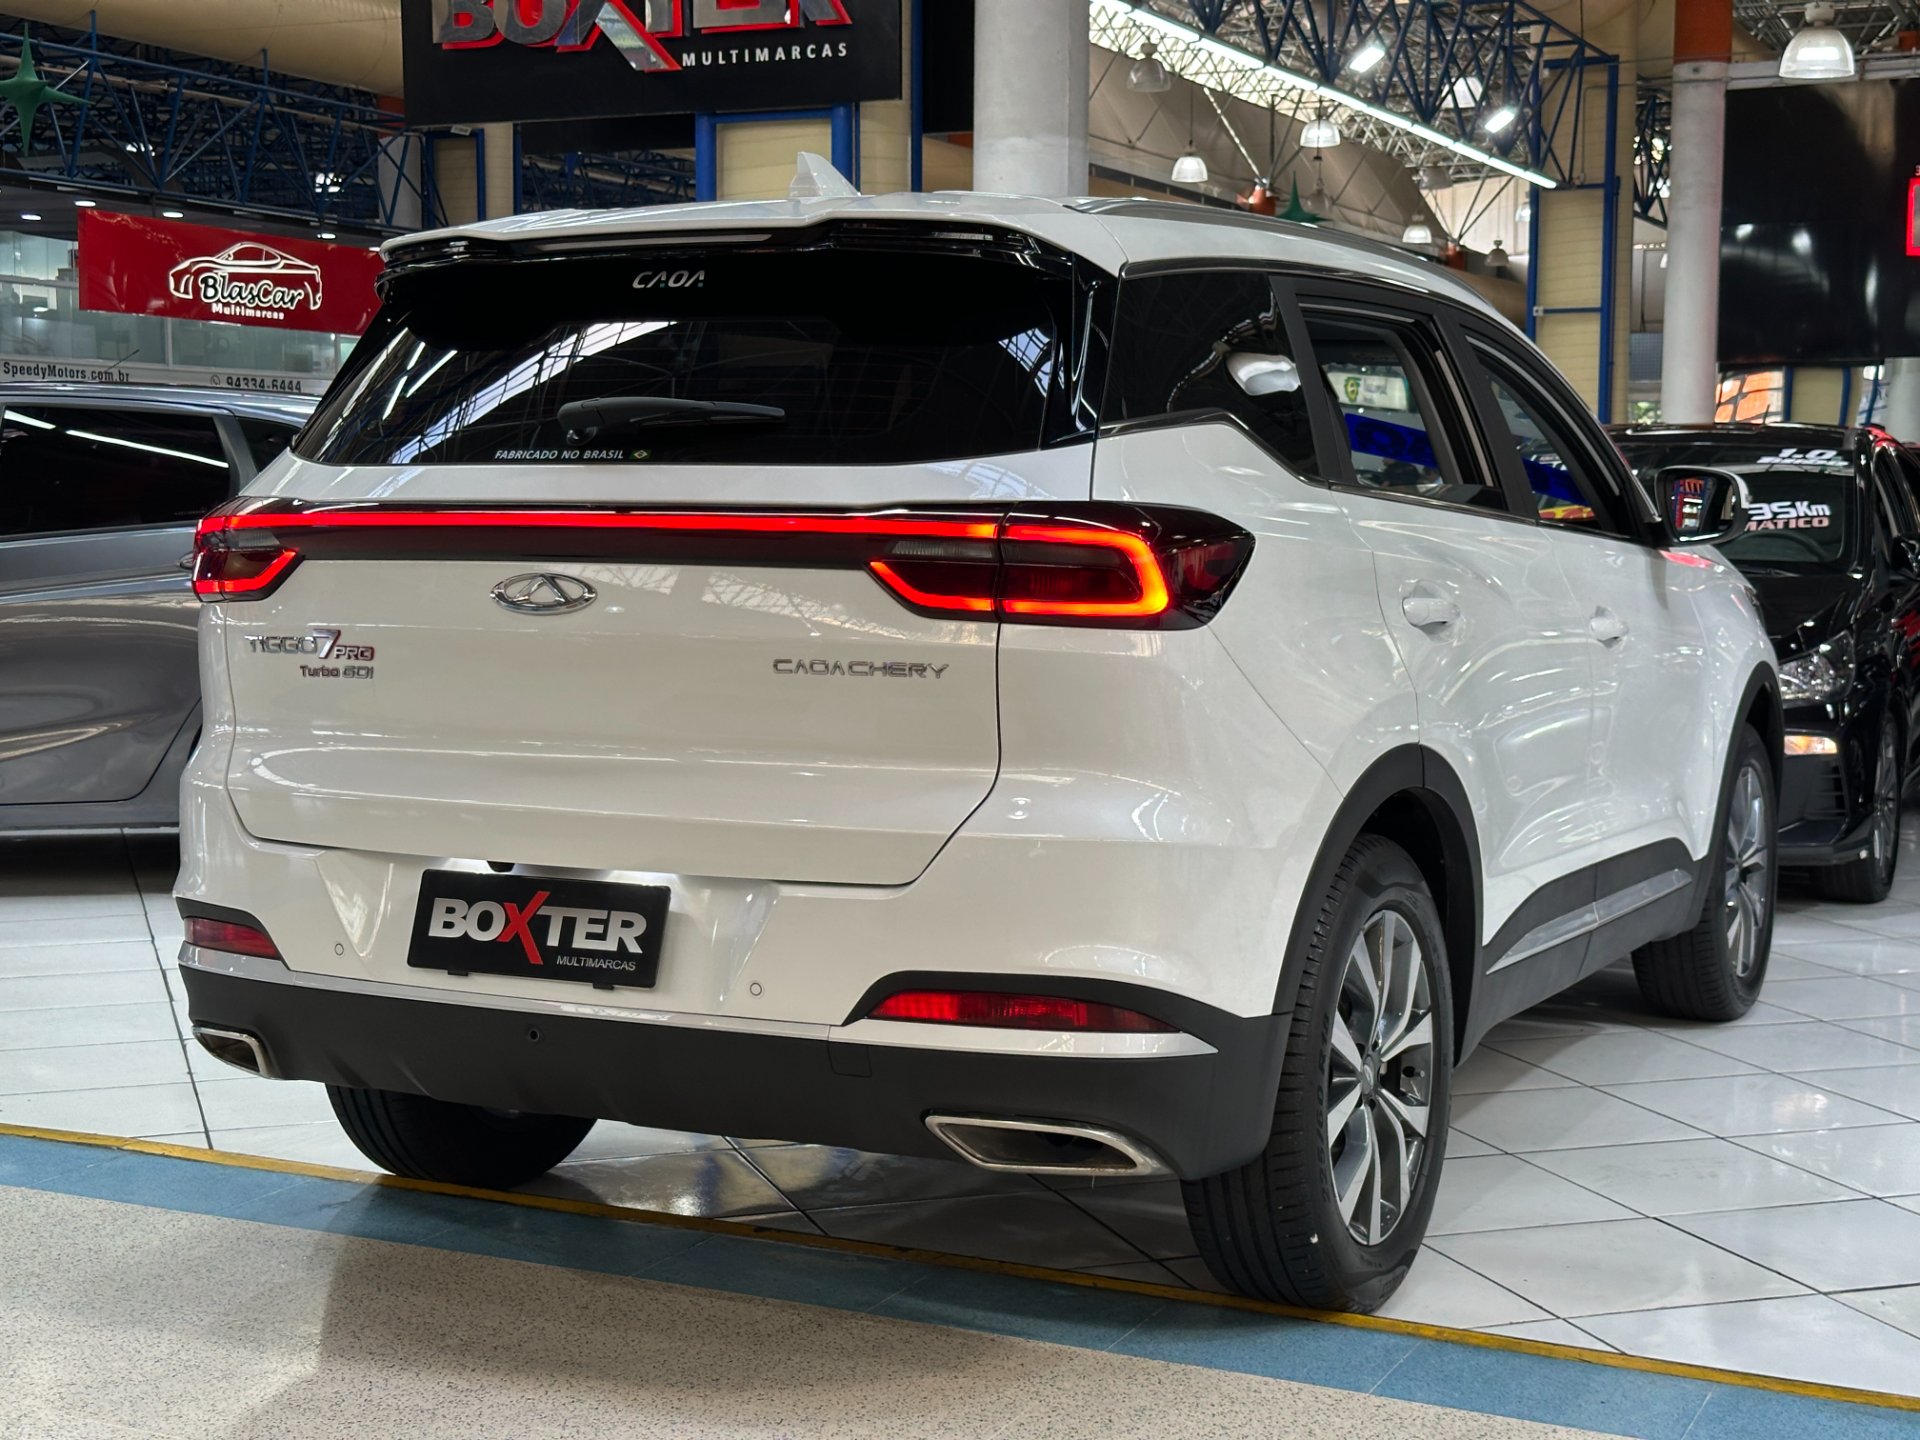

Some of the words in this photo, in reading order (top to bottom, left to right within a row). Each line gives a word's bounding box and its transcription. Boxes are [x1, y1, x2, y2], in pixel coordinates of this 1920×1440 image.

[682, 42, 848, 68] MULTIMARCAS
[199, 271, 305, 310] BlasCar
[211, 302, 286, 321] Multimarcas
[3, 361, 130, 383] SpeedyMotors.com.br
[494, 450, 558, 460] FABRICADO
[561, 450, 580, 460] NO
[583, 450, 624, 459] BRASIL
[299, 665, 341, 678] Turbo
[427, 890, 648, 966] BOXTER
[556, 954, 637, 972] MULTIMARCAS
